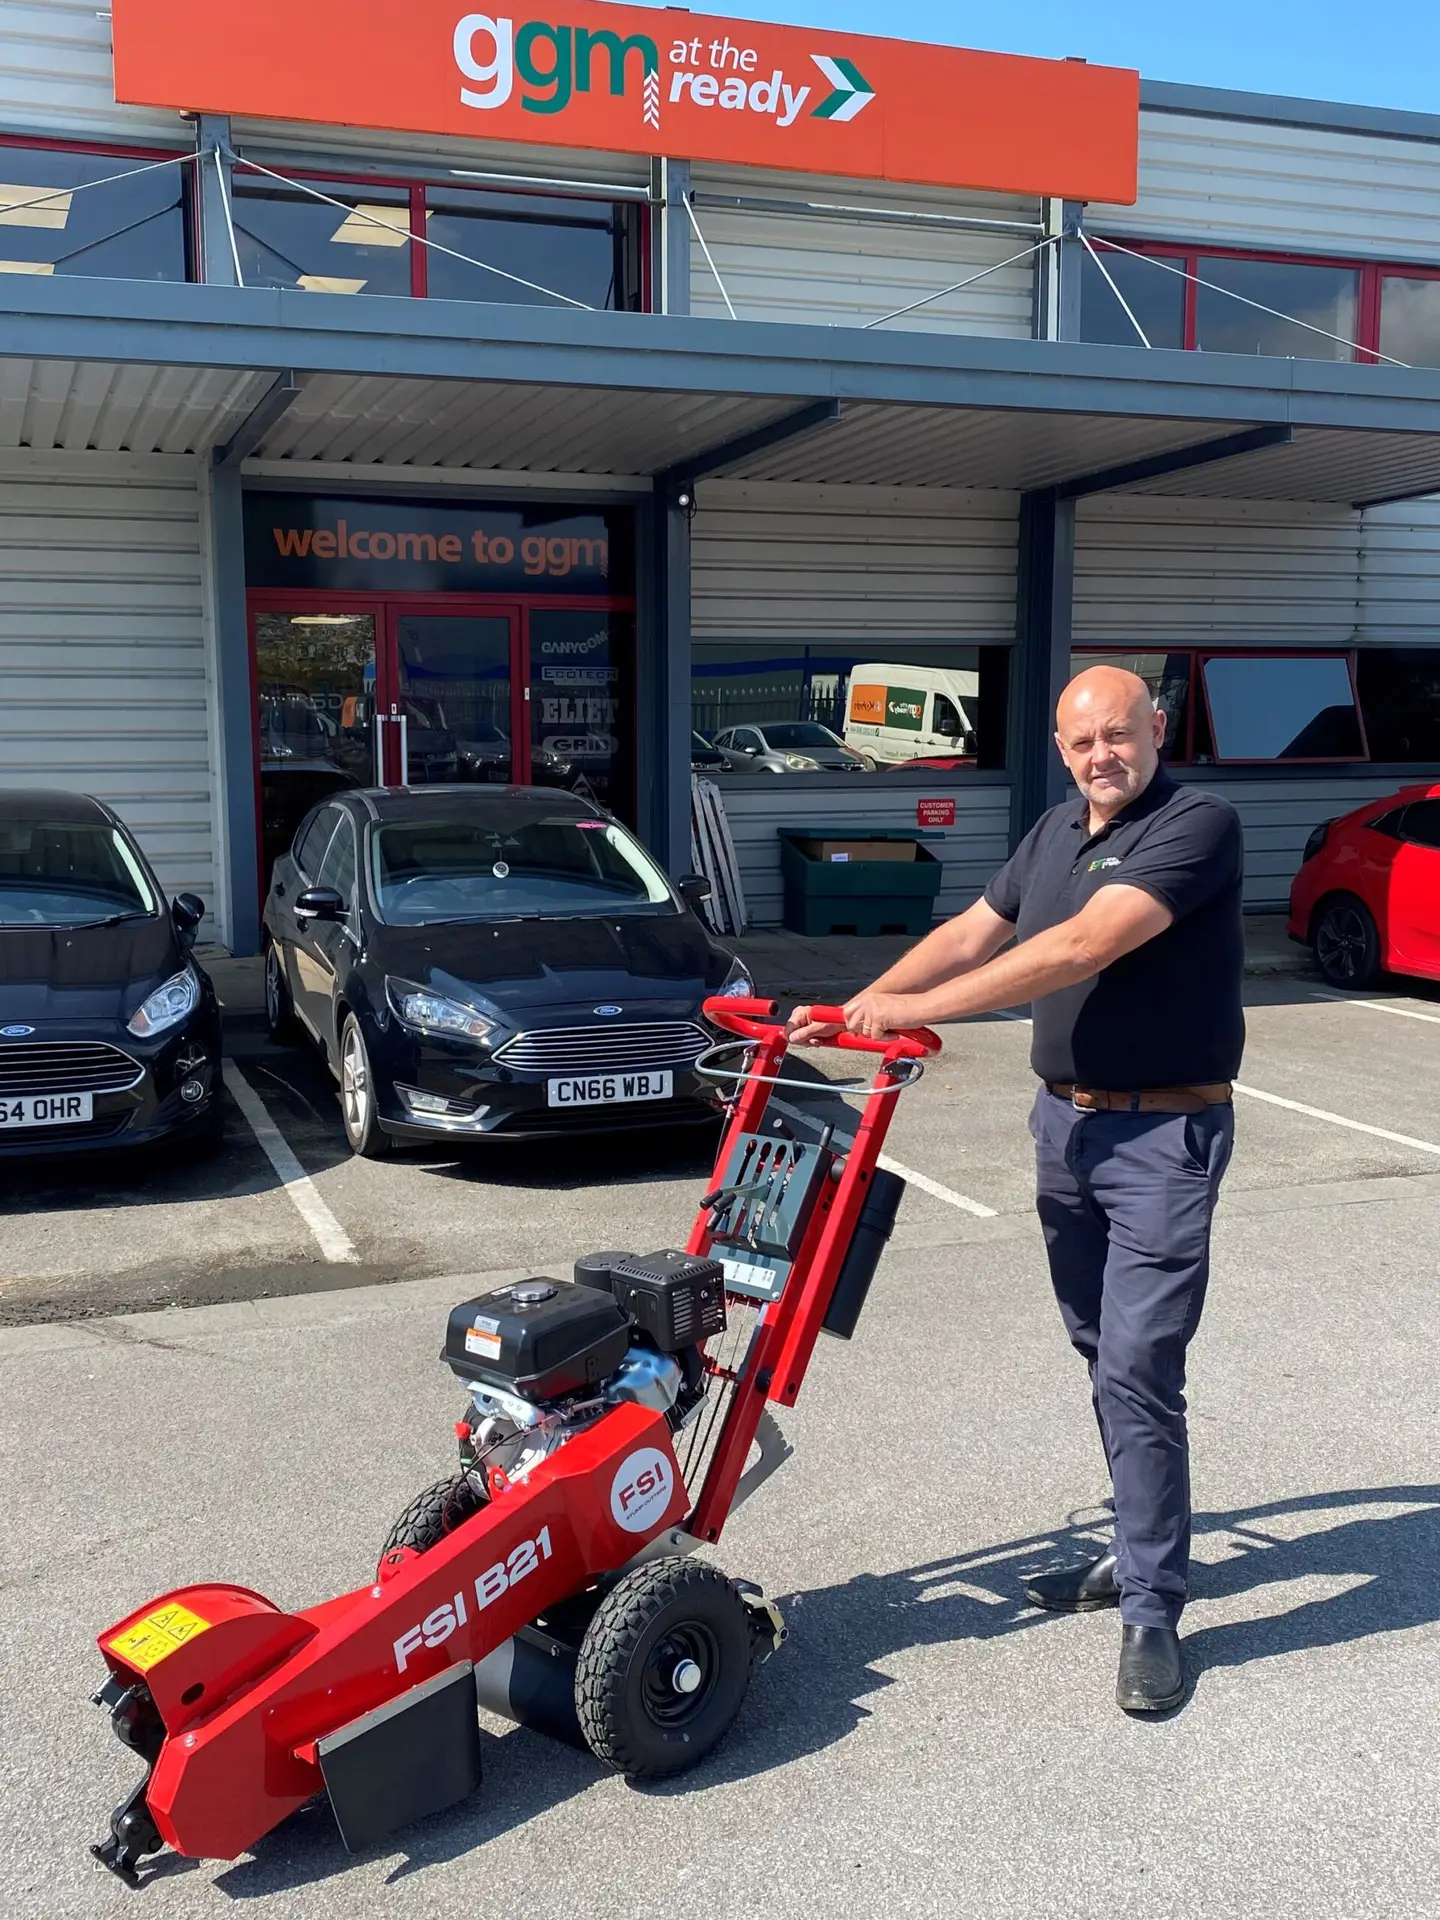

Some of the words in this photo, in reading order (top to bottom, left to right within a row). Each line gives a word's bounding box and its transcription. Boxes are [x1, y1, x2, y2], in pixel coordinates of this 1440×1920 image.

[453, 13, 659, 126] ggm
[669, 37, 702, 65] at
[709, 39, 758, 71] the
[668, 71, 811, 127] ready
[273, 519, 462, 561] welcome
[471, 529, 514, 563] to
[521, 535, 608, 577] ggm
[542, 698, 619, 724] ELIET
[33, 1096, 82, 1120] OHR
[557, 1078, 616, 1102] CN66
[622, 1074, 664, 1097] WBJ
[619, 1462, 664, 1512] FSI
[393, 1591, 467, 1674] FSI
[474, 1525, 553, 1611] B21
